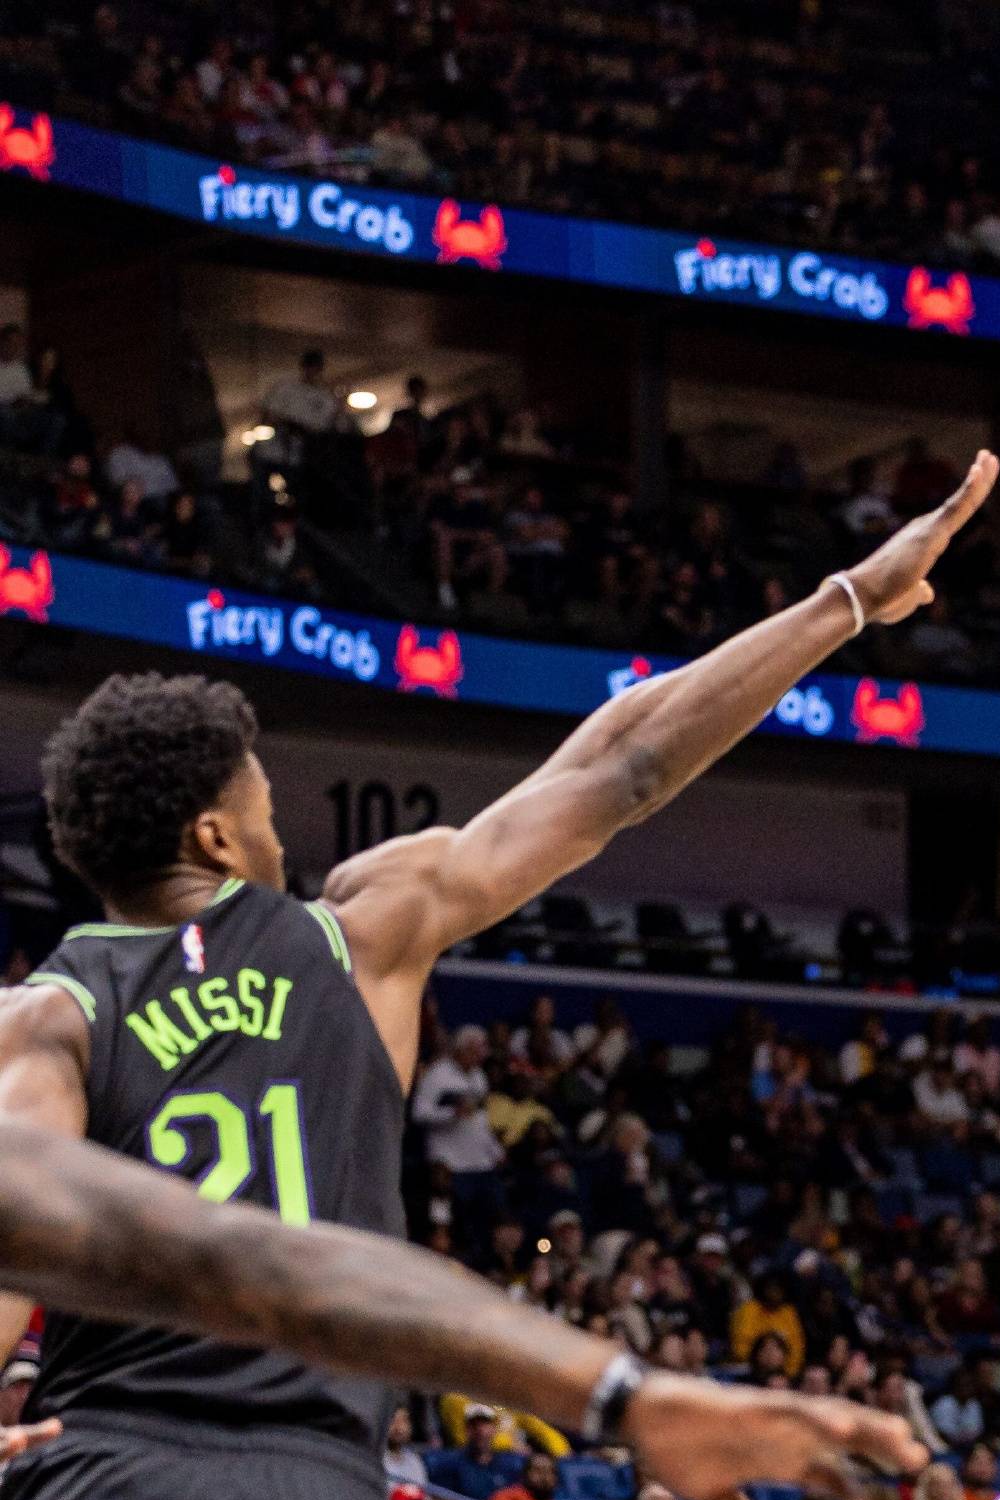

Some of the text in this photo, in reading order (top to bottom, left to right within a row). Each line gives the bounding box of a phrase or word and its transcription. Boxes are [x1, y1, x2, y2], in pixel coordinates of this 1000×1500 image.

[199, 166, 300, 230] Fiery
[675, 239, 781, 300] Fiery
[186, 588, 284, 657] Fiery
[125, 967, 293, 1071] MISSI
[147, 1081, 314, 1229] 21
